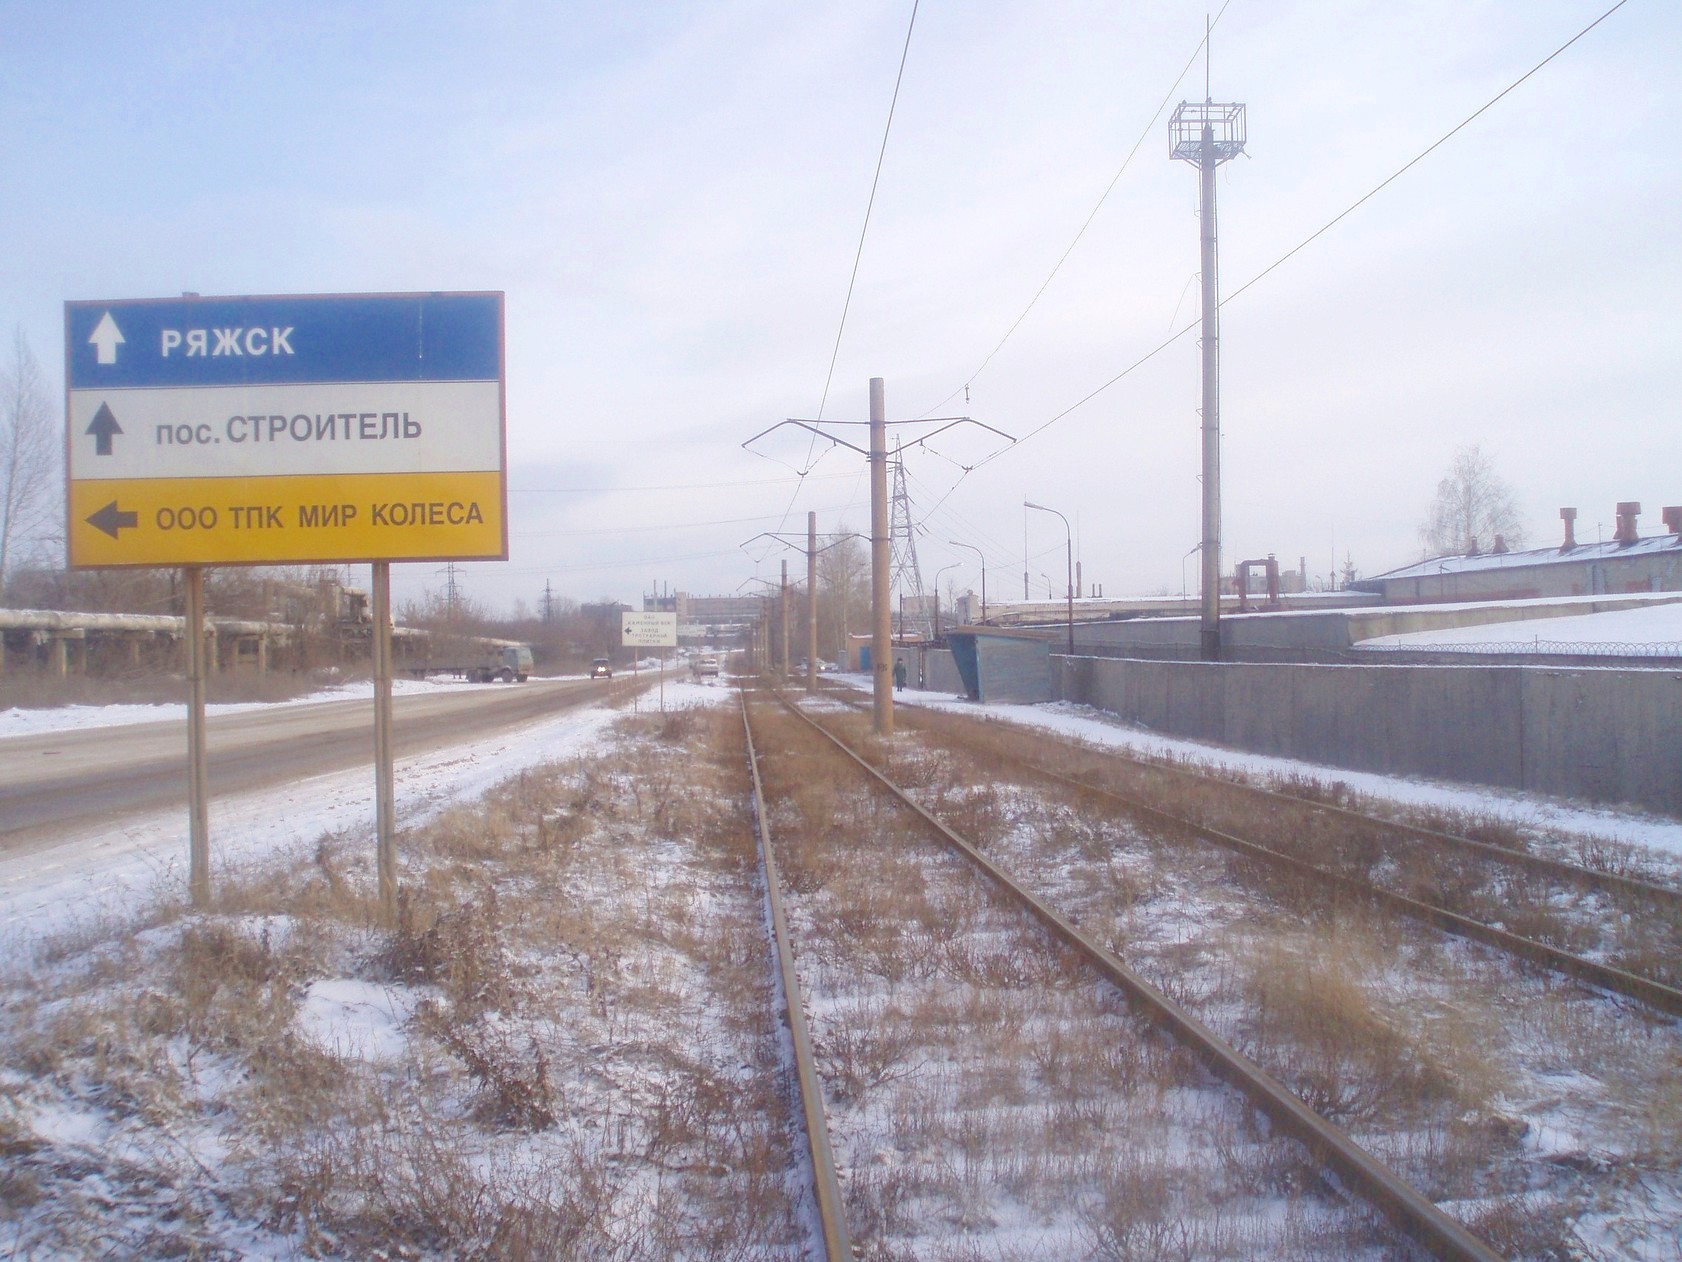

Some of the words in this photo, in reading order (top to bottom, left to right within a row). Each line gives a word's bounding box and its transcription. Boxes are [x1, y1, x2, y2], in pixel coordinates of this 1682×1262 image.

[161, 326, 295, 358] РЯЖСК
[156, 422, 220, 445] пос.
[226, 412, 422, 443] СТРОИТЕЛЬ
[155, 506, 218, 531] ООО
[228, 505, 284, 529] ТПК
[298, 504, 357, 528] МИР
[371, 501, 484, 527] КОЛЕСА
